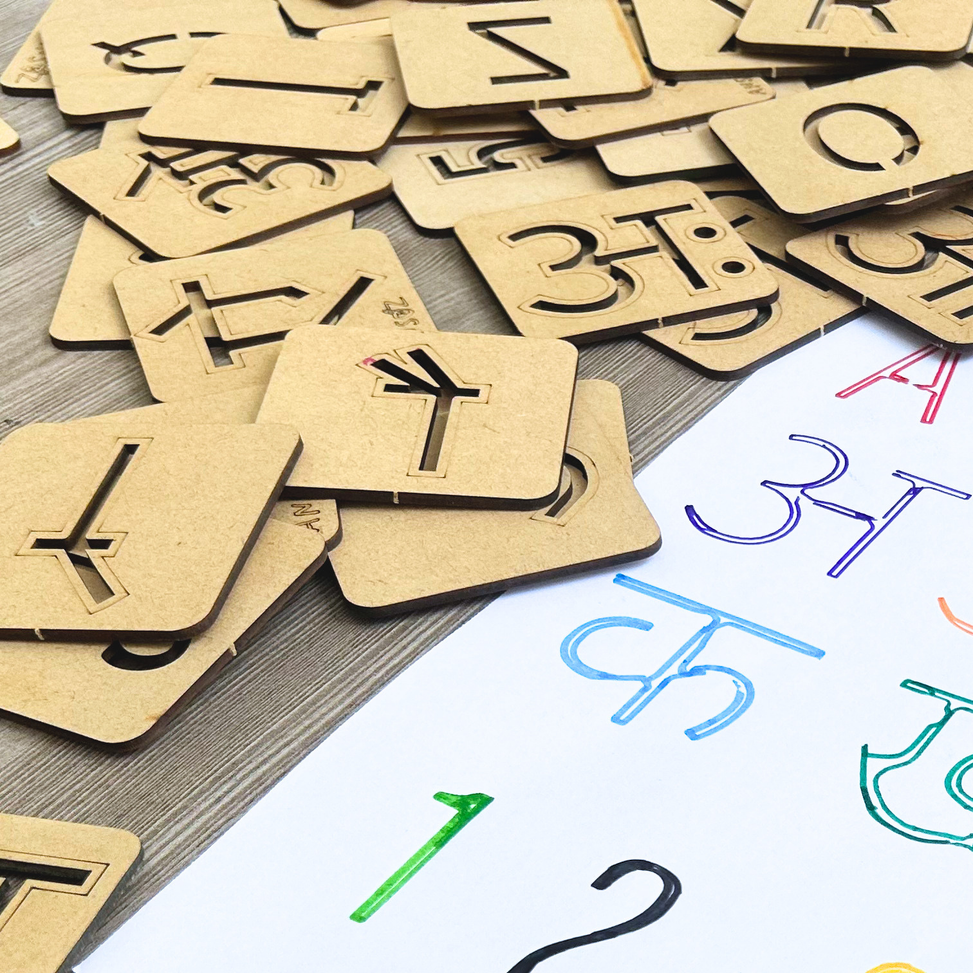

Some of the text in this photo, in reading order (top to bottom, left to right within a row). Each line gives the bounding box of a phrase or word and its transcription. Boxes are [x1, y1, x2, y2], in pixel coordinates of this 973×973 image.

[835, 345, 962, 425] A
[684, 433, 972, 578] अ
[559, 572, 827, 741] क
[349, 790, 495, 924] 1
